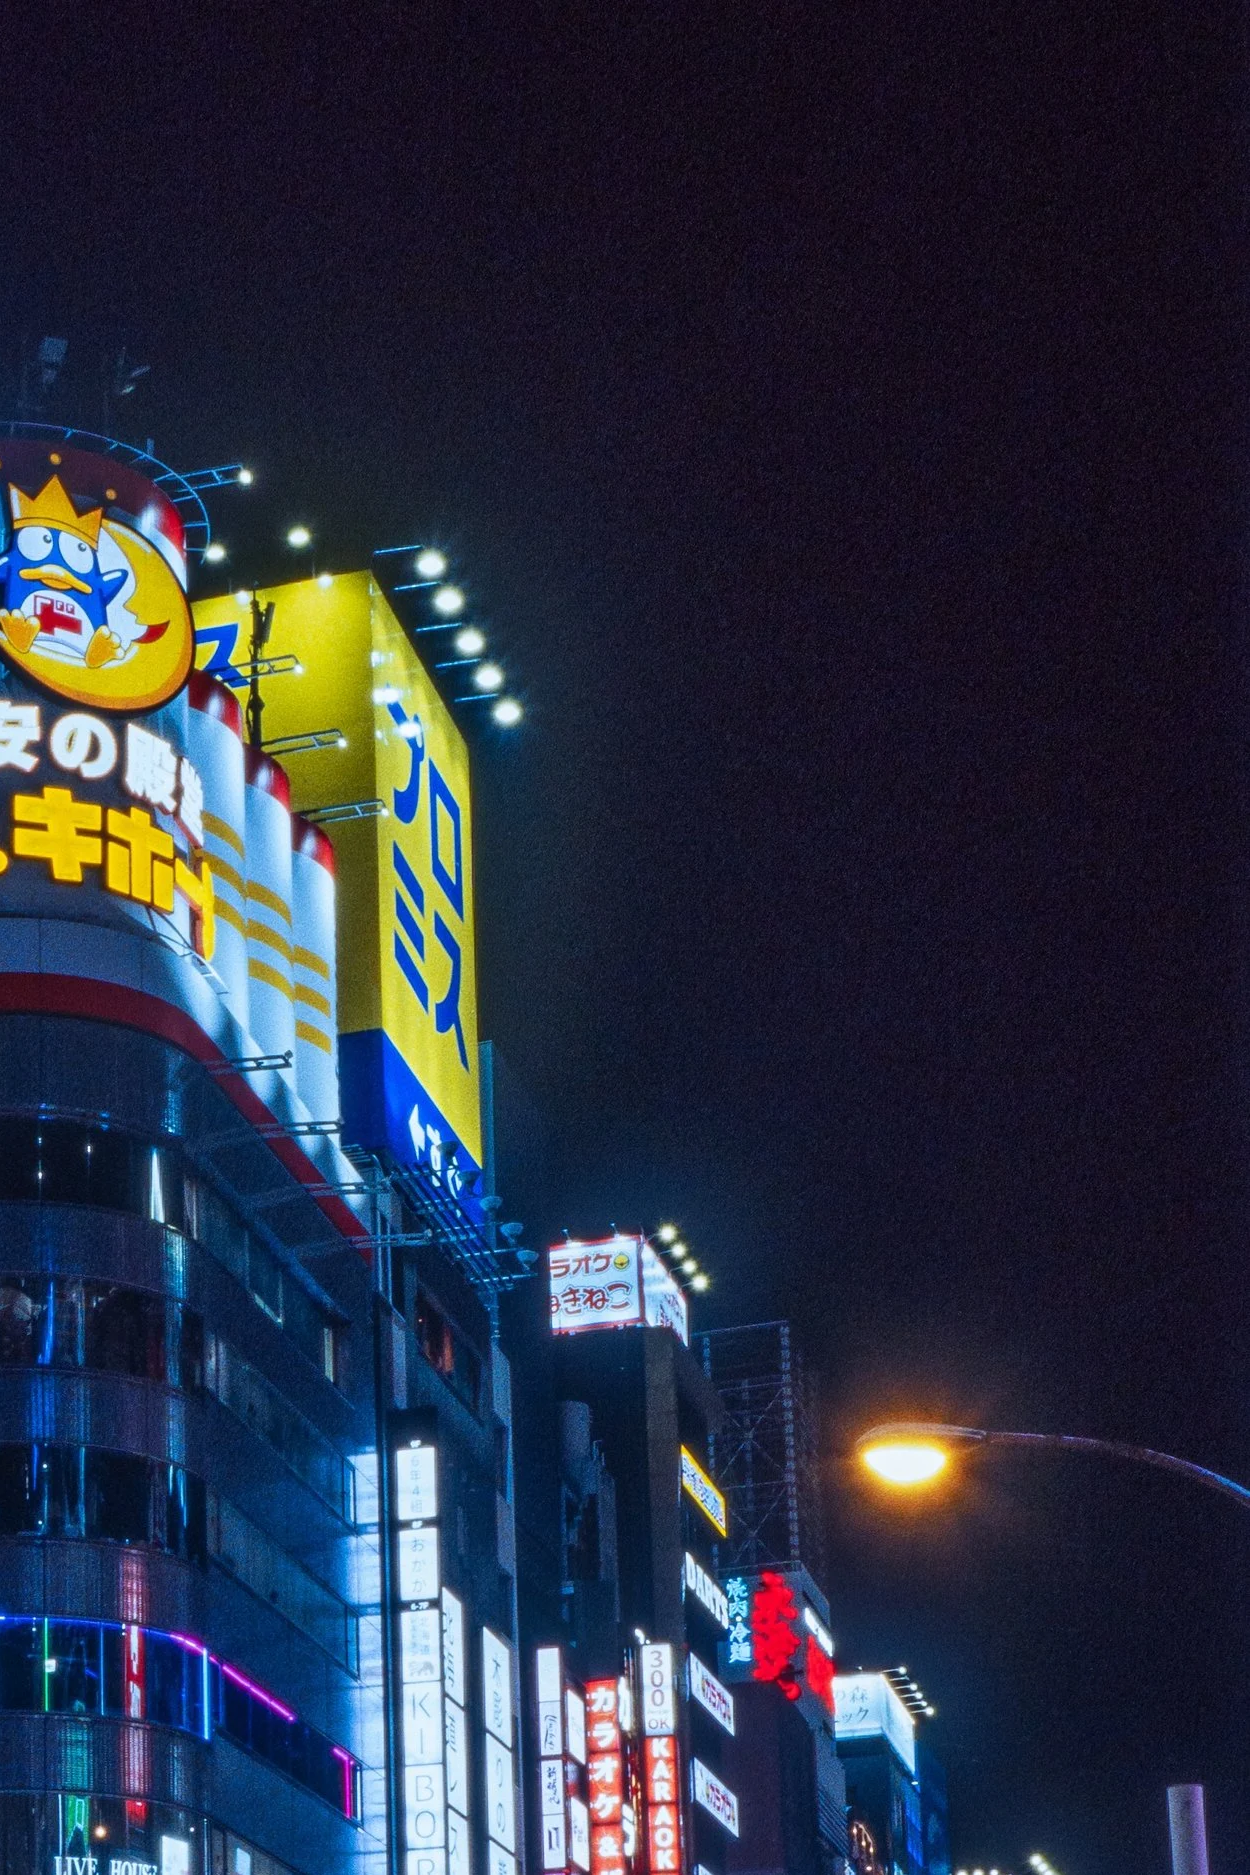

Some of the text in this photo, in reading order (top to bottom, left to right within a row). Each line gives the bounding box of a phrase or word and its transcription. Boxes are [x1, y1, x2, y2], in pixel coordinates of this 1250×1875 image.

[685, 1552, 729, 1629] DARTS
[649, 1650, 665, 1707] 300
[648, 1717, 671, 1731] OK
